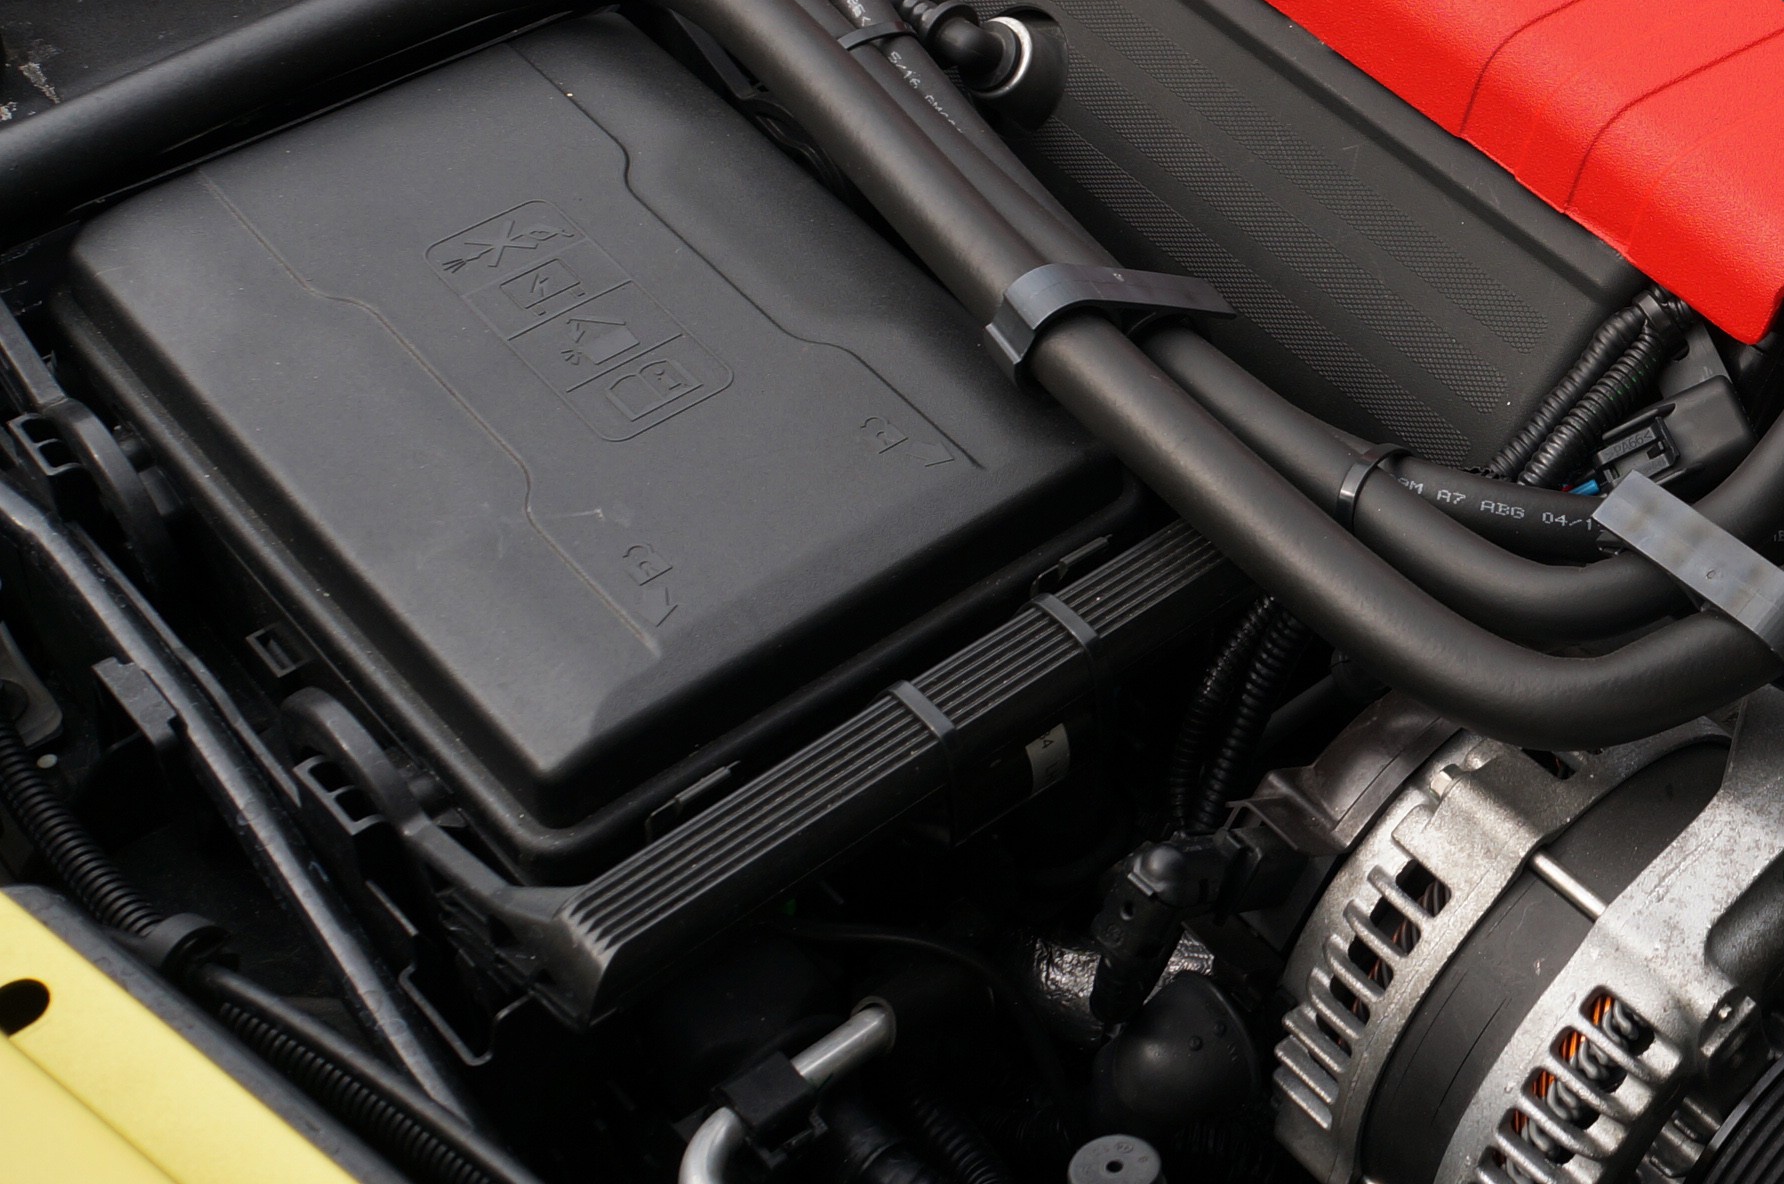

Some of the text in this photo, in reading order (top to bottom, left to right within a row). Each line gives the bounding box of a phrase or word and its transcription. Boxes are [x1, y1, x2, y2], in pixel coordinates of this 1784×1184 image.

[1436, 489, 1598, 530] A7 ABG 04/1
